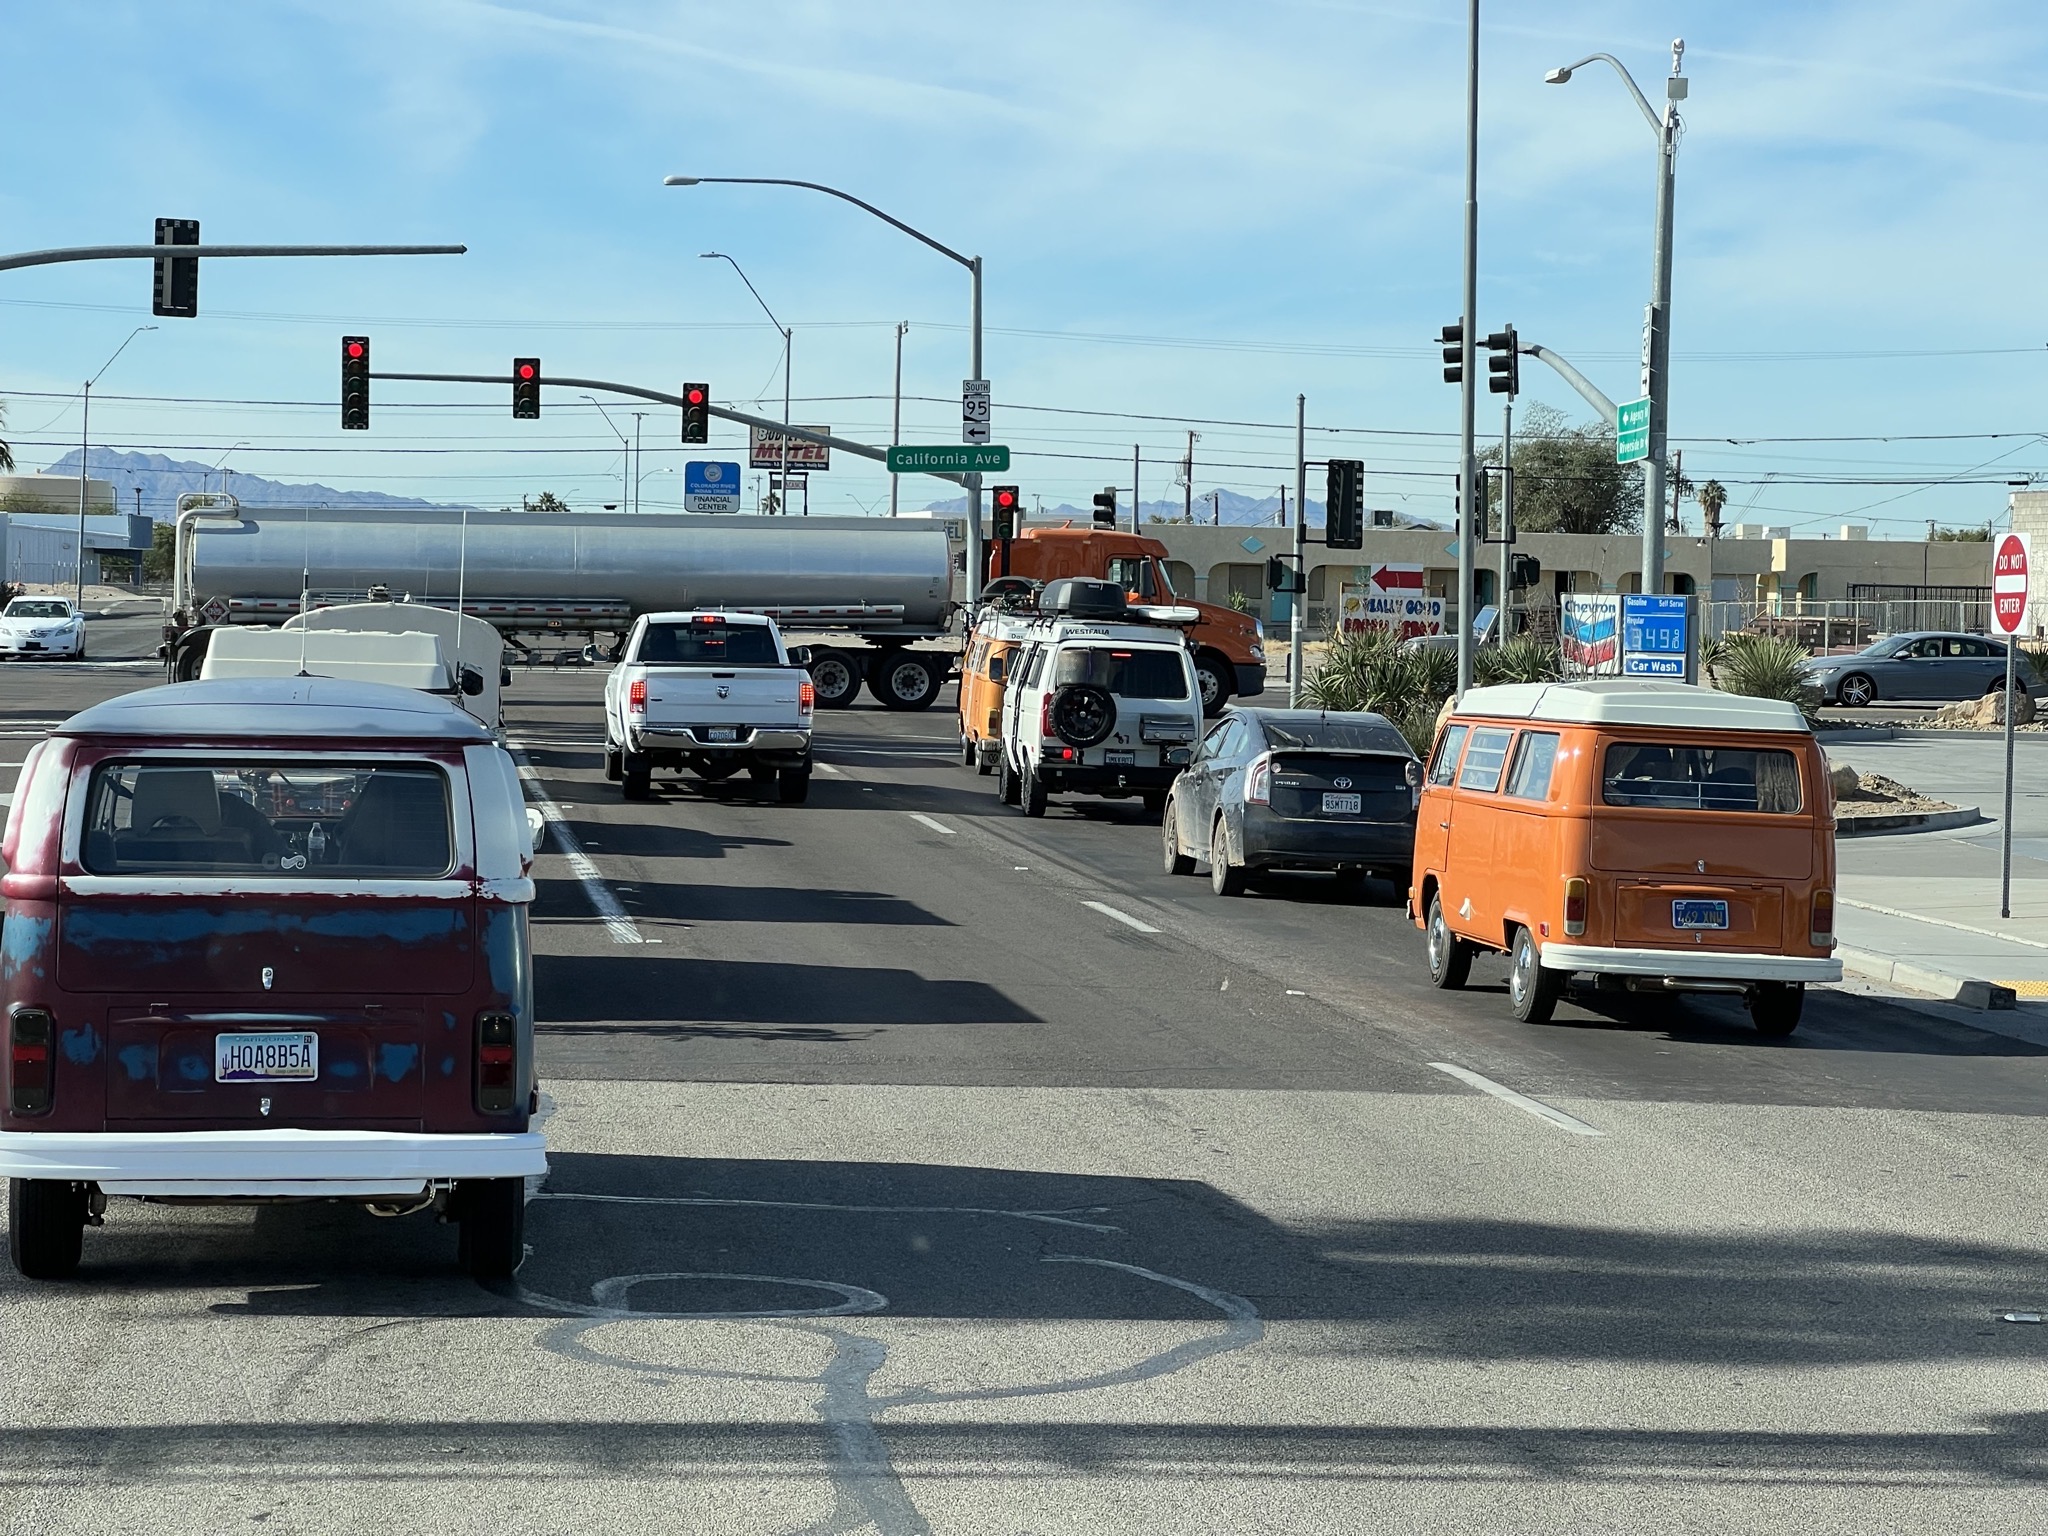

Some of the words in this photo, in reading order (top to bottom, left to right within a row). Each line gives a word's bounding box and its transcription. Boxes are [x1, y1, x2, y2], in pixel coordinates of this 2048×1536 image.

[965, 382, 989, 391] SOUTH
[966, 401, 987, 416] 95
[1629, 409, 1644, 425] Agency
[755, 443, 826, 460] MOTEL
[1619, 438, 1639, 454] Riverside
[896, 453, 968, 465] California
[975, 453, 1001, 465] Ave
[1999, 555, 2008, 570] DO
[2010, 553, 2024, 570] NOT
[1565, 600, 1616, 613] Chevron
[1627, 597, 1647, 607] Gasoline
[1658, 599, 1668, 607] Self
[1669, 600, 1684, 608] Serve
[1999, 597, 2020, 614] ENTER
[1626, 616, 1645, 626] Regular
[1631, 661, 1649, 672] Car
[1651, 661, 1677, 672] Wash
[1325, 800, 1359, 811] 8SMT718
[230, 1044, 311, 1069] HOA8B5A
